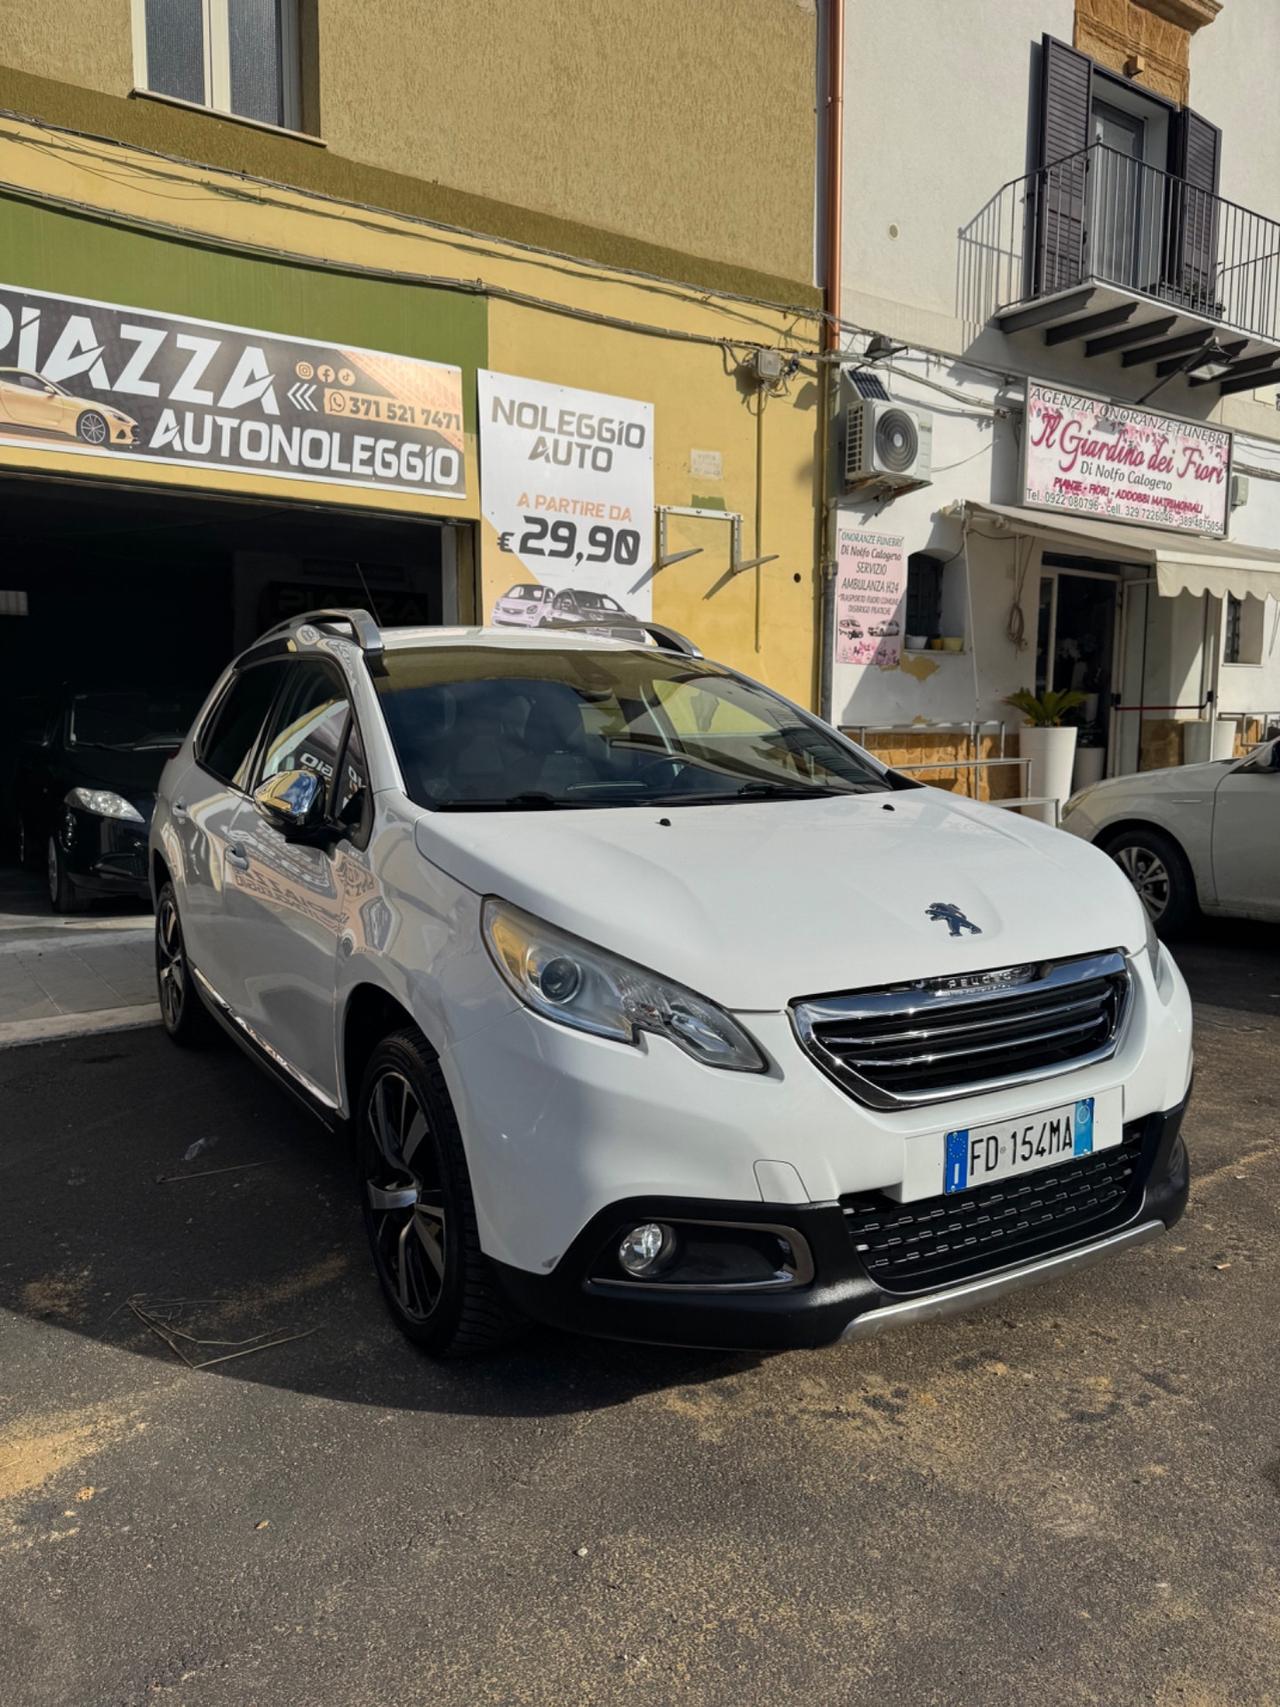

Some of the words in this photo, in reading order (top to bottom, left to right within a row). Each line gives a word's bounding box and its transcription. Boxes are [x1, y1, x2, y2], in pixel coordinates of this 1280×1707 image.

[349, 395, 381, 419] 371
[387, 402, 418, 424] 521
[421, 408, 461, 432] 7471
[491, 395, 646, 450] NOLEGGIO
[1031, 387, 1095, 414] AGENZIA
[1099, 404, 1174, 434] ONORANZE
[1175, 423, 1228, 446] FUNEBRI
[148, 407, 460, 487] AUTONOLEGGIO
[528, 435, 614, 473] AUTO
[1058, 419, 1145, 473] Giardino
[1147, 436, 1175, 475] dei
[1176, 446, 1225, 485] Fiori
[1080, 460, 1093, 476] Di
[1095, 464, 1125, 482] Nolfo
[1127, 470, 1173, 492] Calogero
[516, 491, 531, 508] A
[534, 494, 605, 519] PARTIRE
[608, 505, 633, 523] DA
[1045, 491, 1066, 506] 0922
[1089, 483, 1110, 497] FIORI
[1115, 489, 1150, 504] ADDOBBI
[1150, 495, 1204, 514] MATRIMONIALI
[841, 577, 885, 593] AMBULANZA
[856, 560, 888, 576] SERVIZIO
[969, 1135, 999, 1177] FD
[1010, 1115, 1074, 1166] 154MA
